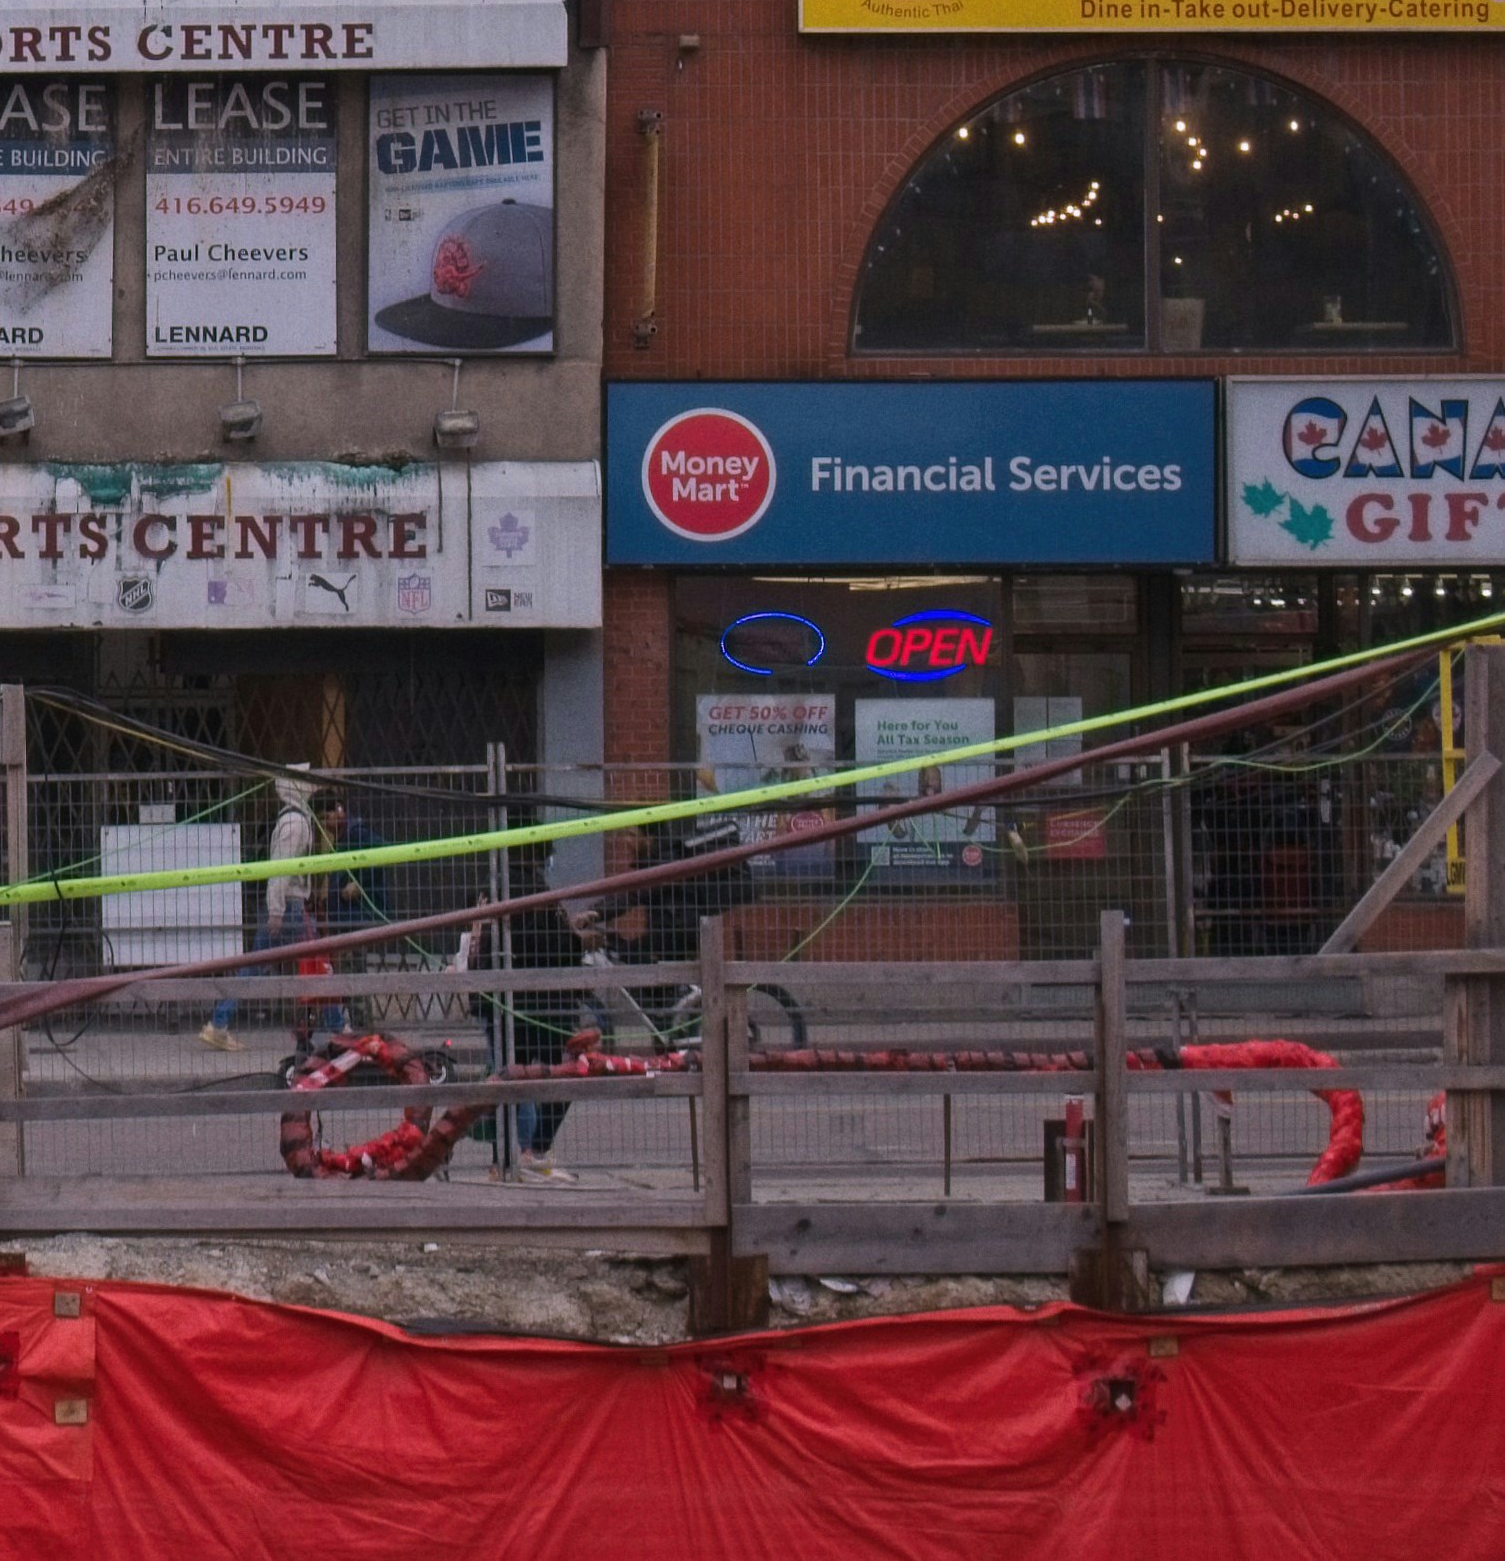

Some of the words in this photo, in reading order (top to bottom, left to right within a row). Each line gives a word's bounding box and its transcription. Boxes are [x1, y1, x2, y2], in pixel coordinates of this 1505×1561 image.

[136, 22, 374, 62] CENTRE
[153, 81, 328, 132] LEASE
[377, 106, 420, 130] GET
[423, 103, 451, 126] IN
[453, 99, 498, 123] THE
[153, 146, 226, 168] ENTIRE
[231, 145, 328, 167] BUILDING
[375, 120, 545, 175] GAME
[154, 196, 327, 215] 416.649.5949
[154, 243, 199, 262] Paul
[207, 243, 310, 262] Cheevers
[154, 268, 307, 283] pcheevers@lennard.com
[154, 325, 269, 344] LENNARD
[660, 450, 760, 482] Money
[810, 454, 997, 493] Financial
[1008, 454, 1183, 493] Services
[1345, 492, 1505, 544] GIF
[132, 513, 428, 560] CENTRE
[119, 582, 151, 603] NHL
[401, 591, 430, 608] NFL
[866, 627, 993, 667] OPEN
[708, 705, 746, 721] GET
[748, 705, 787, 720] 50%
[792, 705, 829, 720] OFF
[708, 723, 765, 737] CHEQUE
[767, 723, 828, 735] CASHING
[876, 720, 909, 732] Here
[912, 720, 931, 731] for
[934, 720, 959, 731] You
[876, 733, 895, 746] All
[897, 734, 921, 745] Tax
[923, 734, 970, 745] Season
